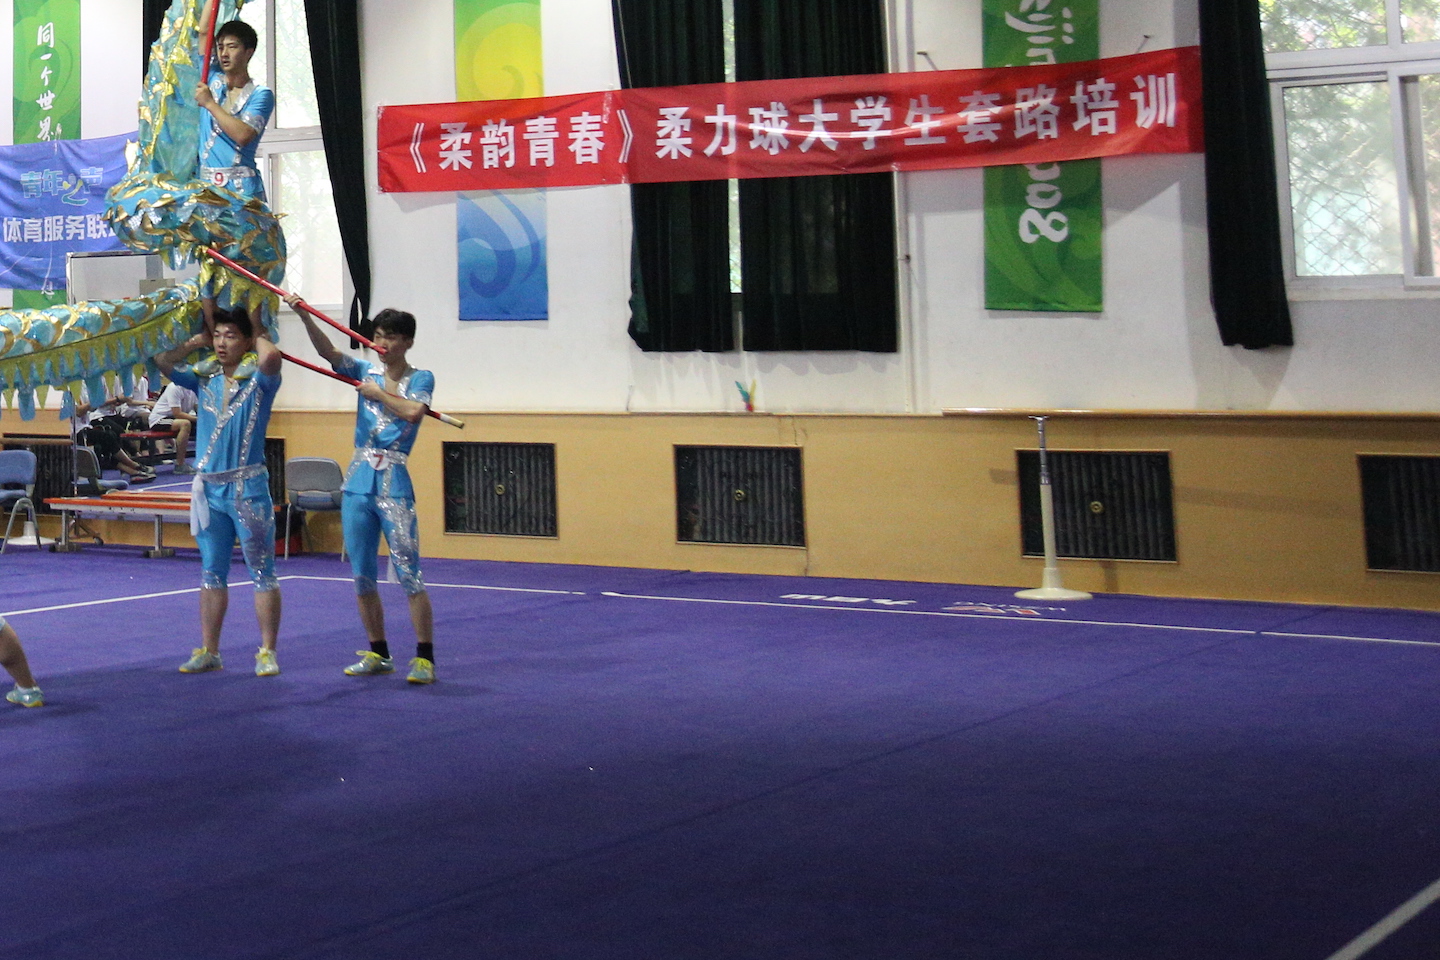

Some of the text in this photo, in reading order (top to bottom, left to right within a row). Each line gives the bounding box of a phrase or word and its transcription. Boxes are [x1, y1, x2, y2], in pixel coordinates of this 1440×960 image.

[20, 166, 104, 206] 青年之声
[214, 172, 224, 186] 9
[1018, 161, 1070, 245] 008
[2, 214, 117, 243] 体育服务联
[373, 453, 384, 469] 7
